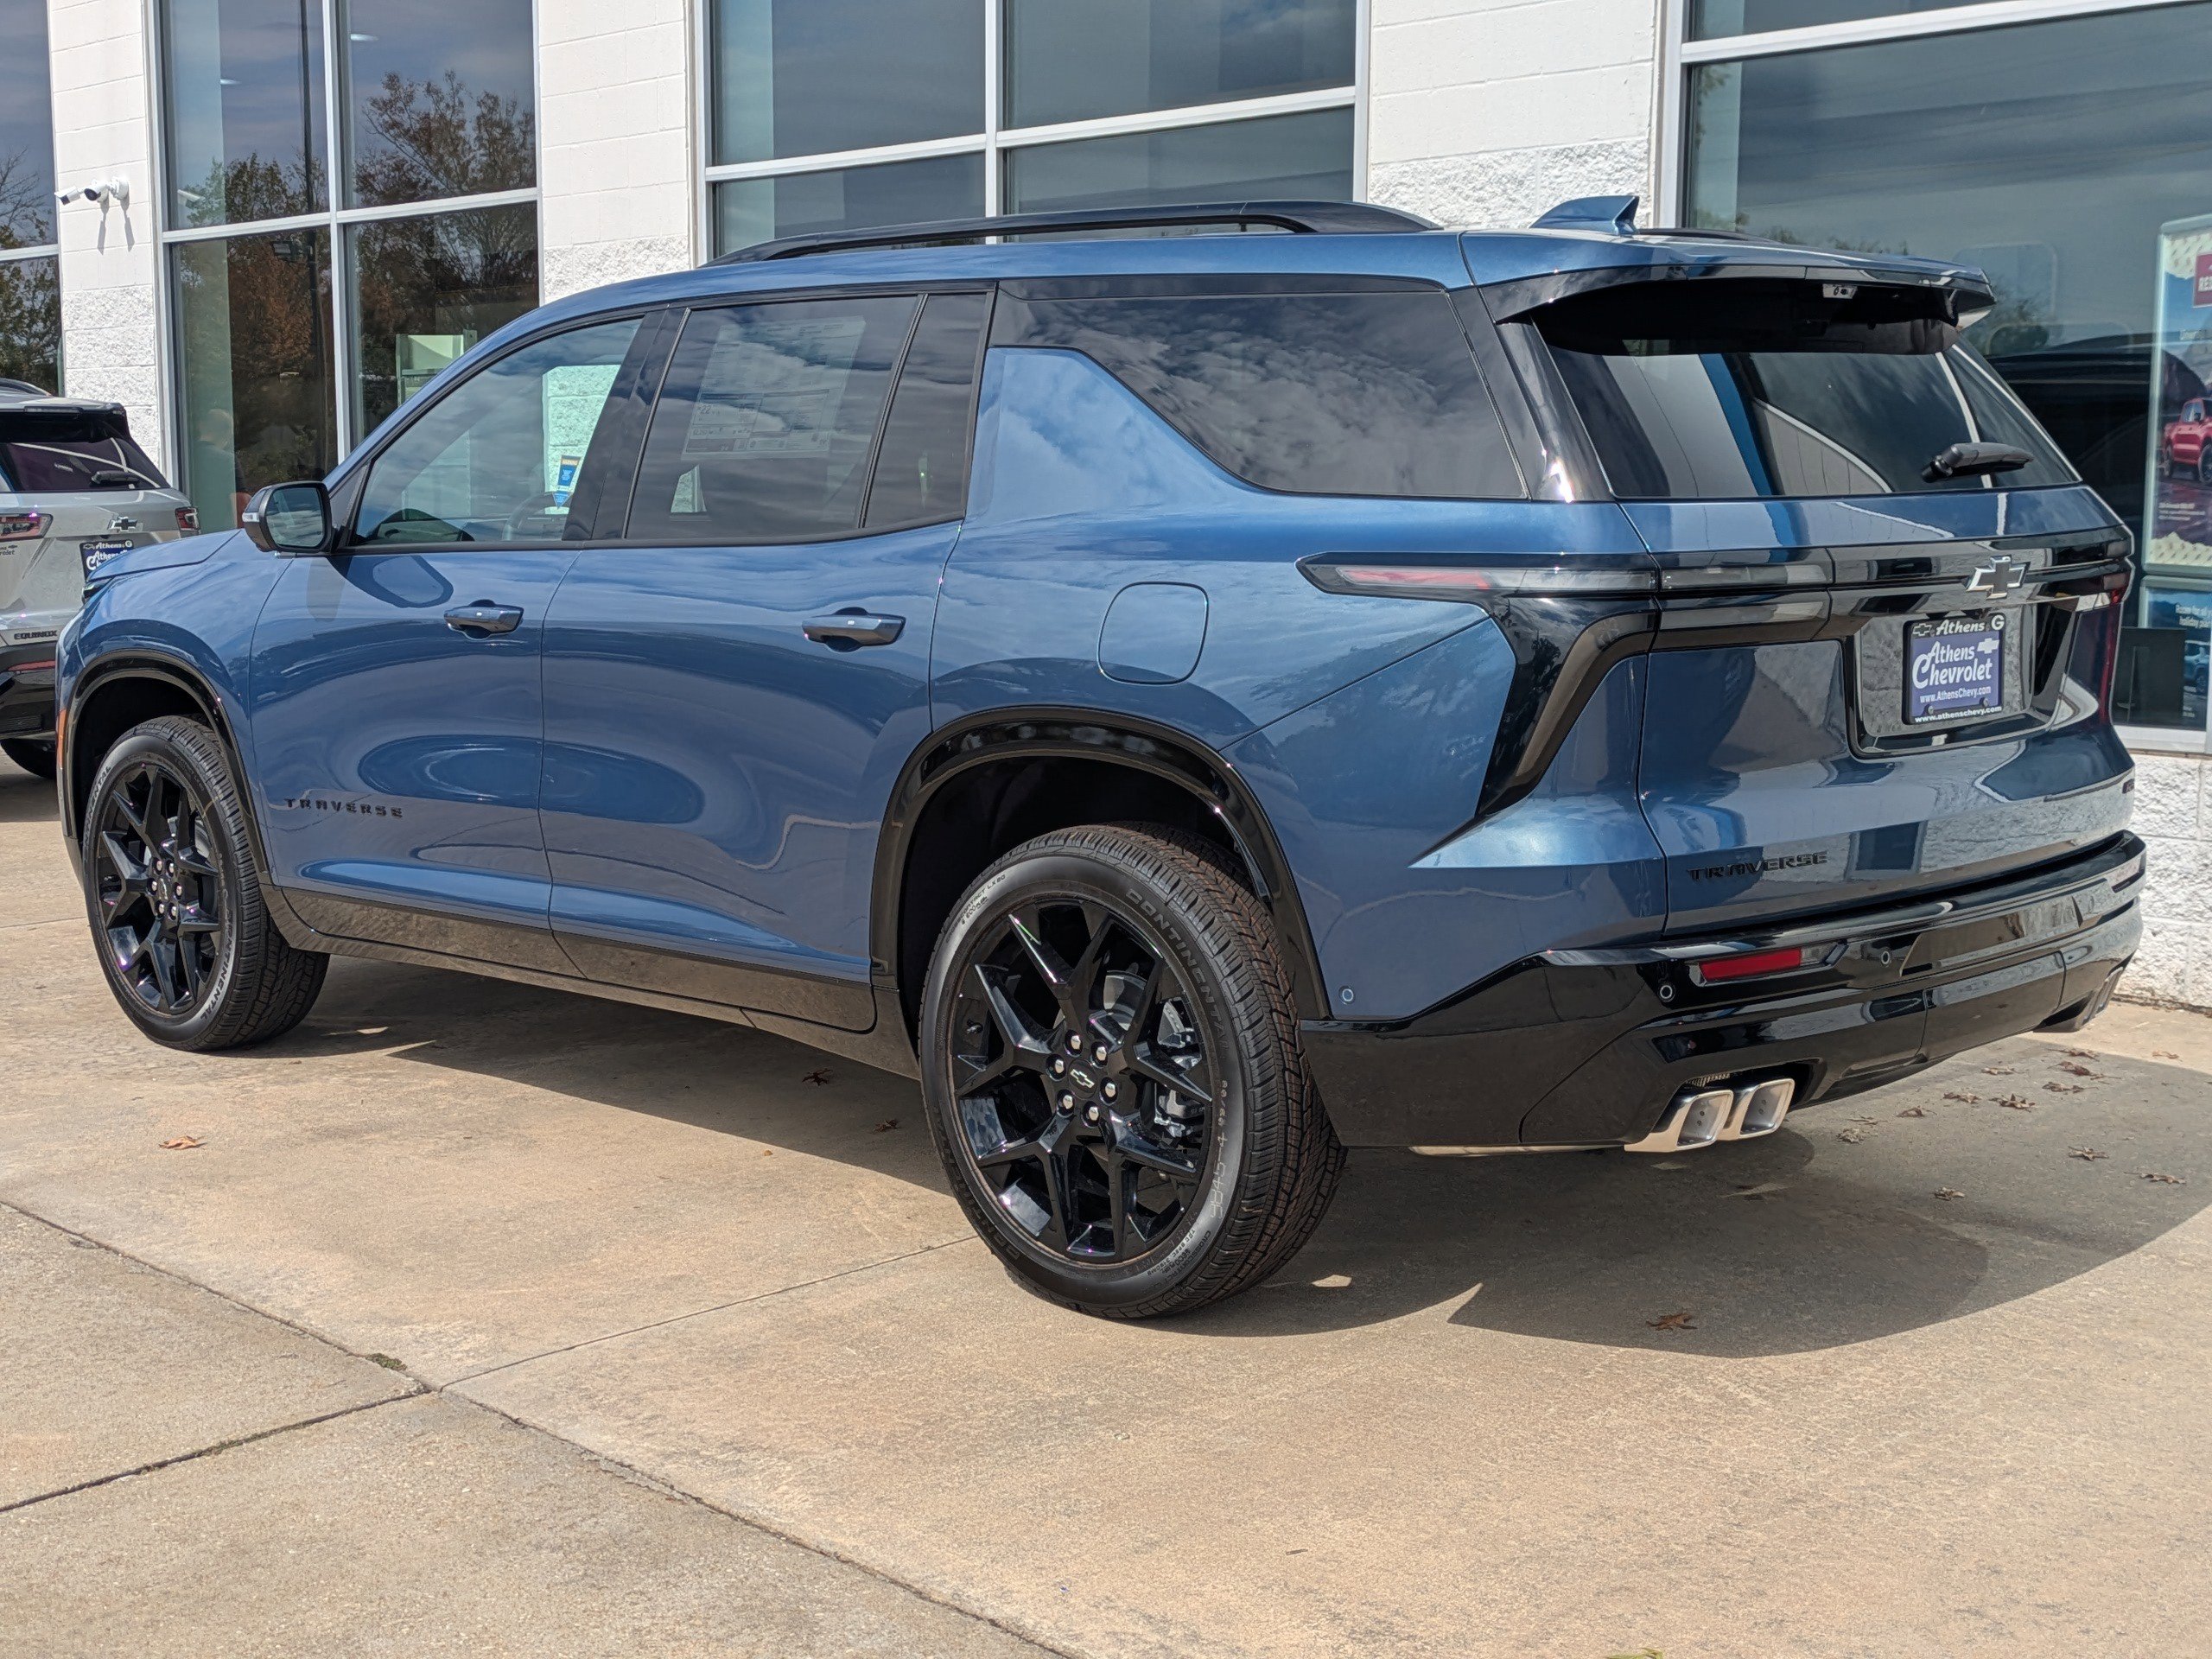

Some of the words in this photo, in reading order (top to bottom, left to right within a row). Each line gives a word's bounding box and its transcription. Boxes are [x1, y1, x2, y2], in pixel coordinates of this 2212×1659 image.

[1936, 619, 1985, 635] Athens
[1991, 614, 2005, 631] G
[14, 630, 58, 640] EQUINOX
[1927, 640, 1975, 664] Athens
[1912, 653, 1993, 690] Chevrolet
[1919, 685, 1992, 704] www.AthensChevy.com
[1914, 705, 2003, 723] www.athenschevy.com
[283, 798, 404, 818] TRAVERSE
[1687, 850, 1829, 881] TRAVERSE
